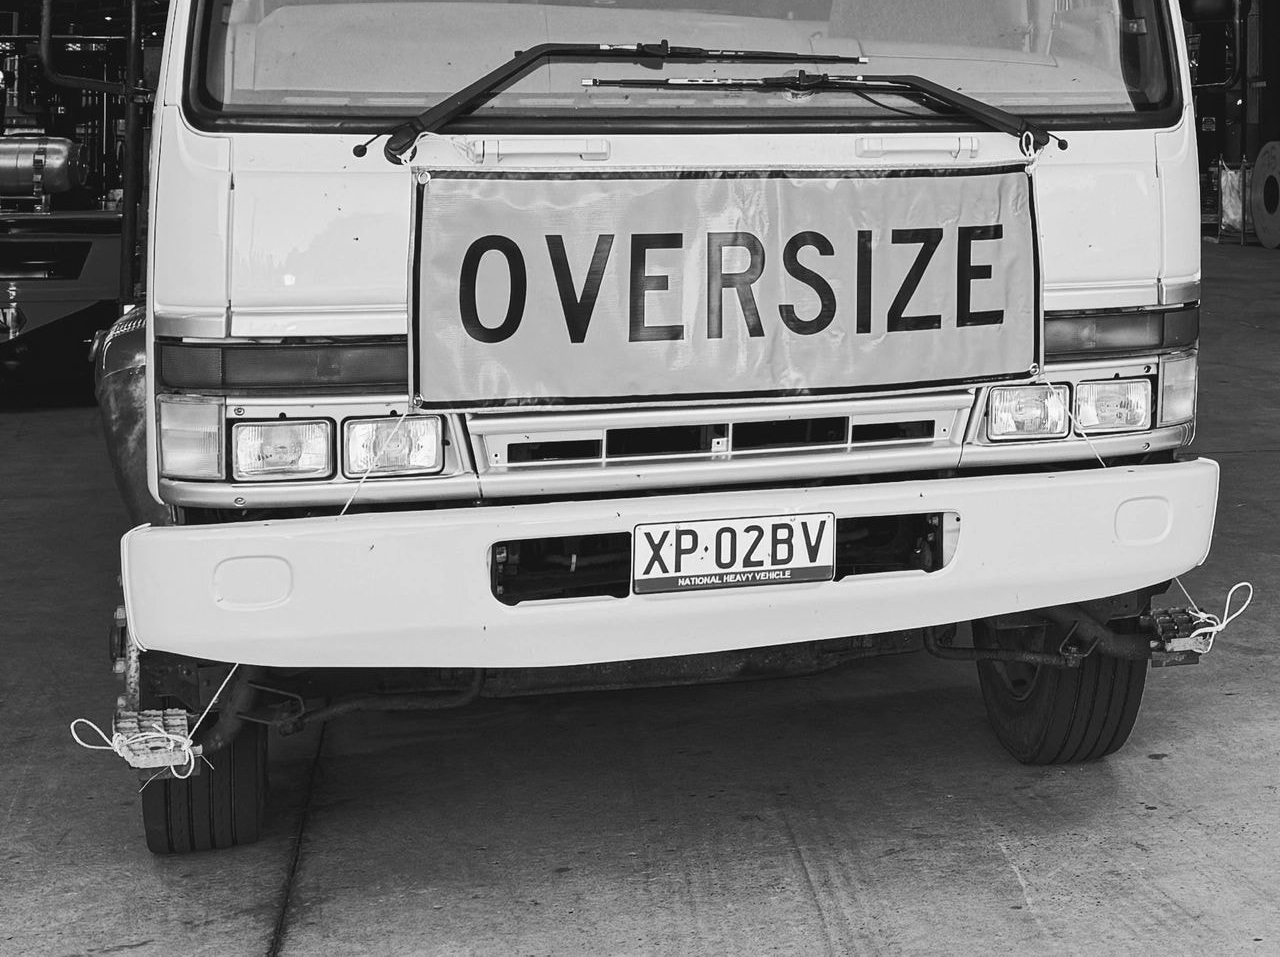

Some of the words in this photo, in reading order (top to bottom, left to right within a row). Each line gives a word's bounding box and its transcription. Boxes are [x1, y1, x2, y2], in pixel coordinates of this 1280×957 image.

[459, 224, 1004, 344] OVERSIZE
[678, 576, 722, 587] NATIONAL
[723, 573, 753, 583] HEAVY
[755, 570, 791, 580] VEHICLE
